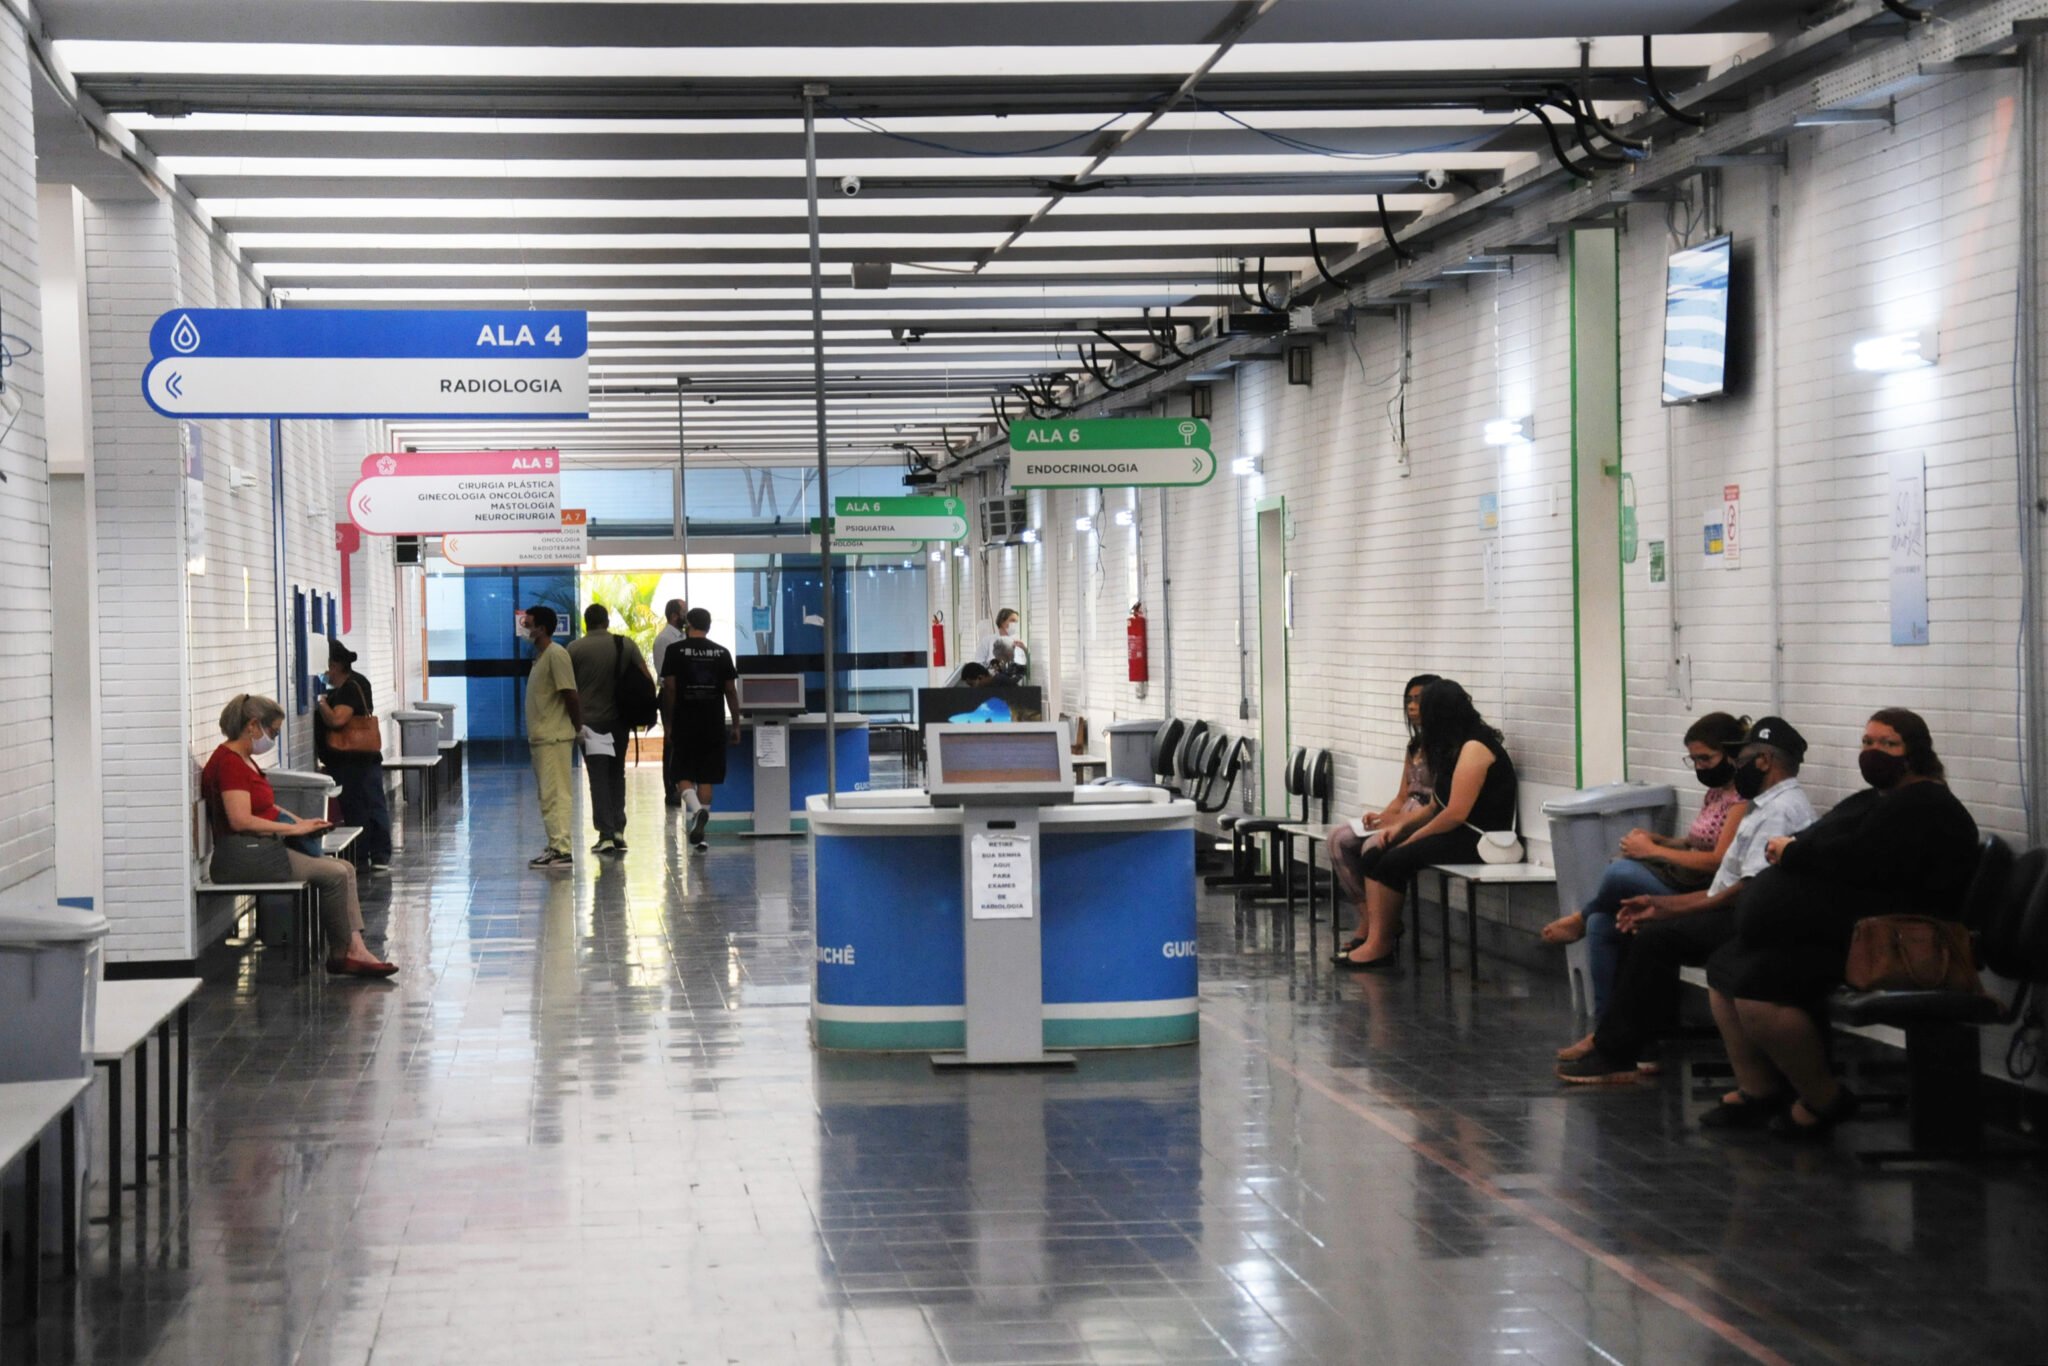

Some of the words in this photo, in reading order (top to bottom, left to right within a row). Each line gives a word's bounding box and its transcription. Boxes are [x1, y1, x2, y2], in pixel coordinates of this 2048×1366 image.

[476, 324, 536, 346] ALA
[544, 324, 563, 346] 4
[440, 379, 562, 393] RADIOLOGIA
[1026, 429, 1063, 443] ALA
[1069, 429, 1080, 442] 6
[512, 457, 541, 469] ALA
[545, 457, 553, 468] 5
[1027, 464, 1138, 474] ENDOCRINOLOGIA
[458, 482, 505, 490] CIRURGIA
[508, 479, 554, 489] PLÁSTICA
[418, 492, 486, 501] GINECOLOGIA
[489, 490, 555, 500] ONCOLÓGICA
[491, 502, 555, 510] MASTOLOGIA
[846, 502, 870, 512] ALA
[873, 502, 881, 511] 6
[475, 512, 555, 521] NEUROCIRURGIA
